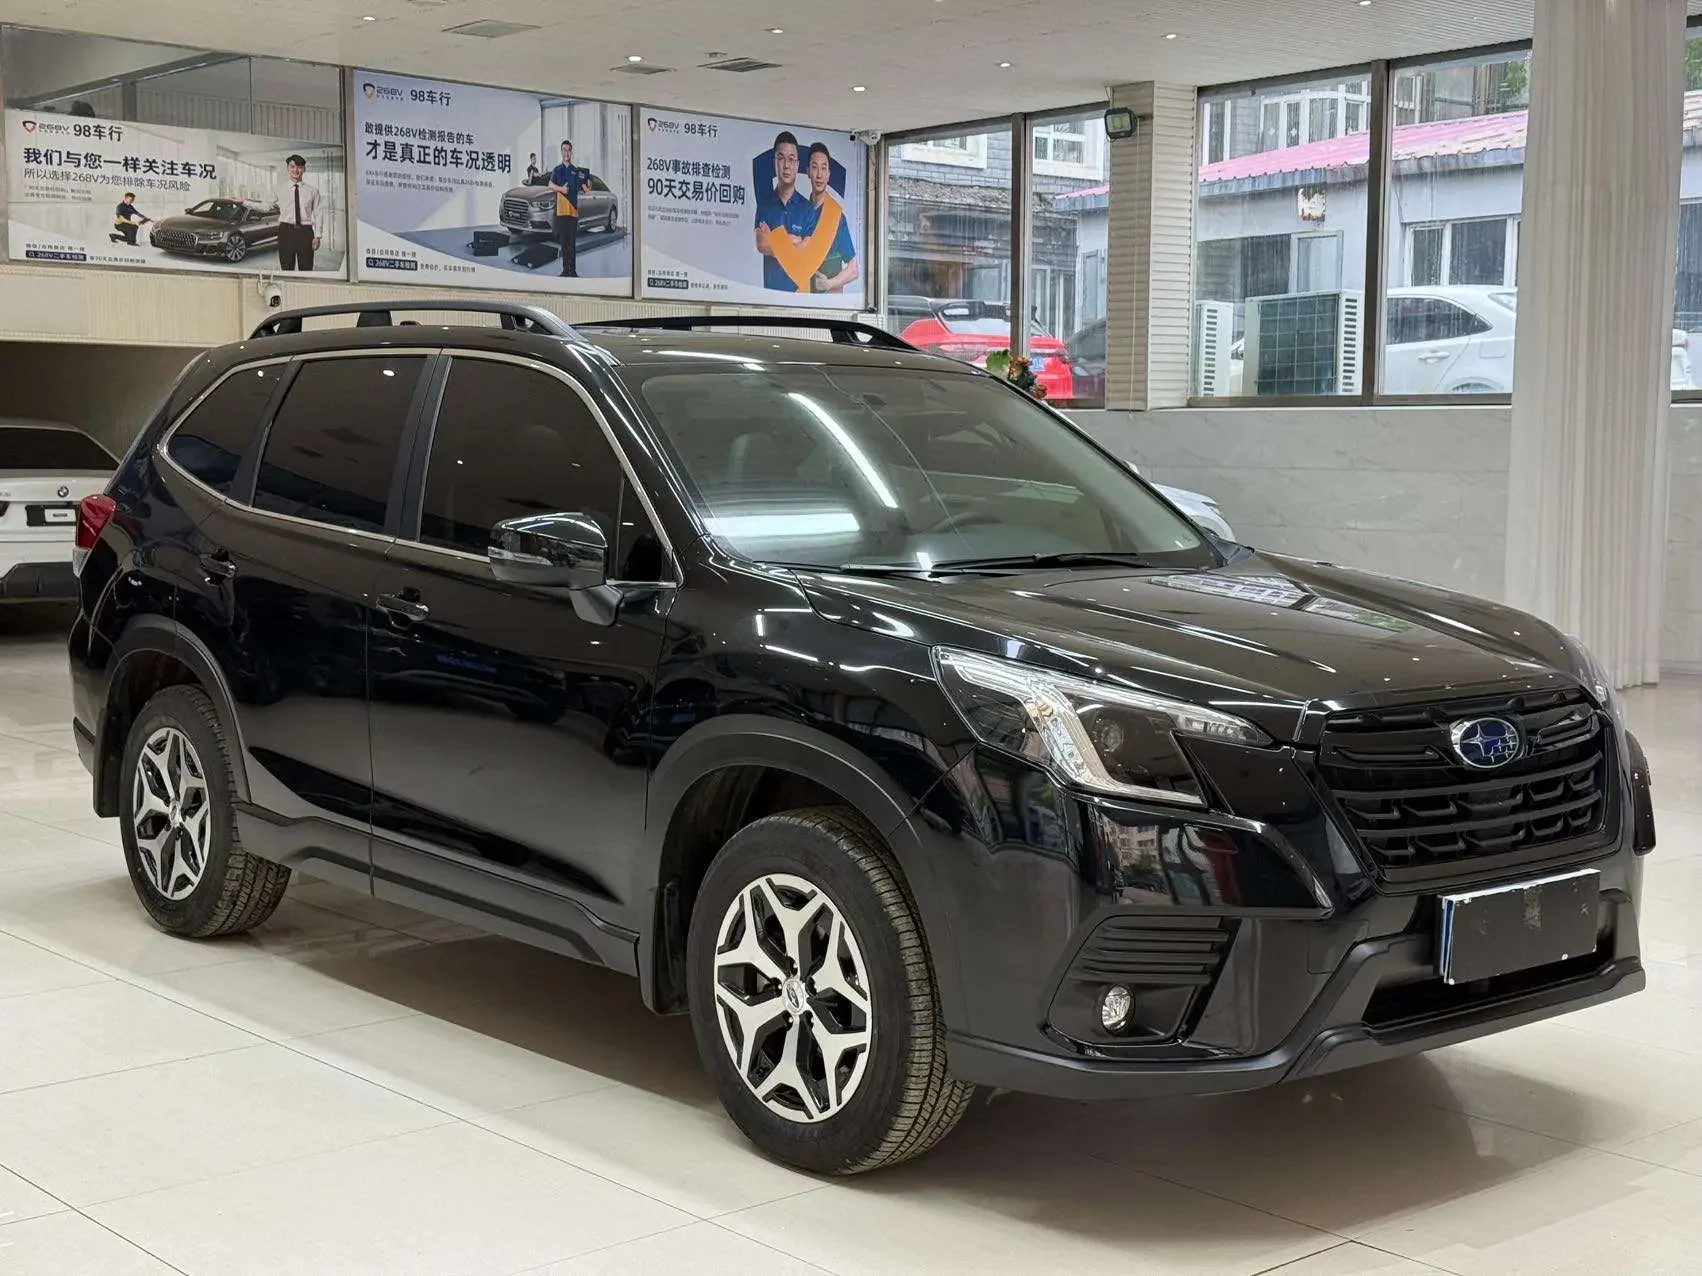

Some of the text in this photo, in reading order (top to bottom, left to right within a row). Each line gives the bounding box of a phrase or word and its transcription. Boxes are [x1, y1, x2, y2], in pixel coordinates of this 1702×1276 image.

[410, 89, 452, 106] 98车行
[73, 123, 123, 142] 98车行
[364, 121, 474, 145] 敢提供268V检测报告的车
[684, 122, 718, 139] 98车行
[23, 147, 217, 180] 我们与您一样关注车况
[365, 139, 512, 173] 才是真正的车况透明
[23, 167, 191, 192] 所以选择268V为您排除车况风险
[647, 157, 731, 180] 268V事故排查检测
[647, 178, 745, 205] 90天交易价回购
